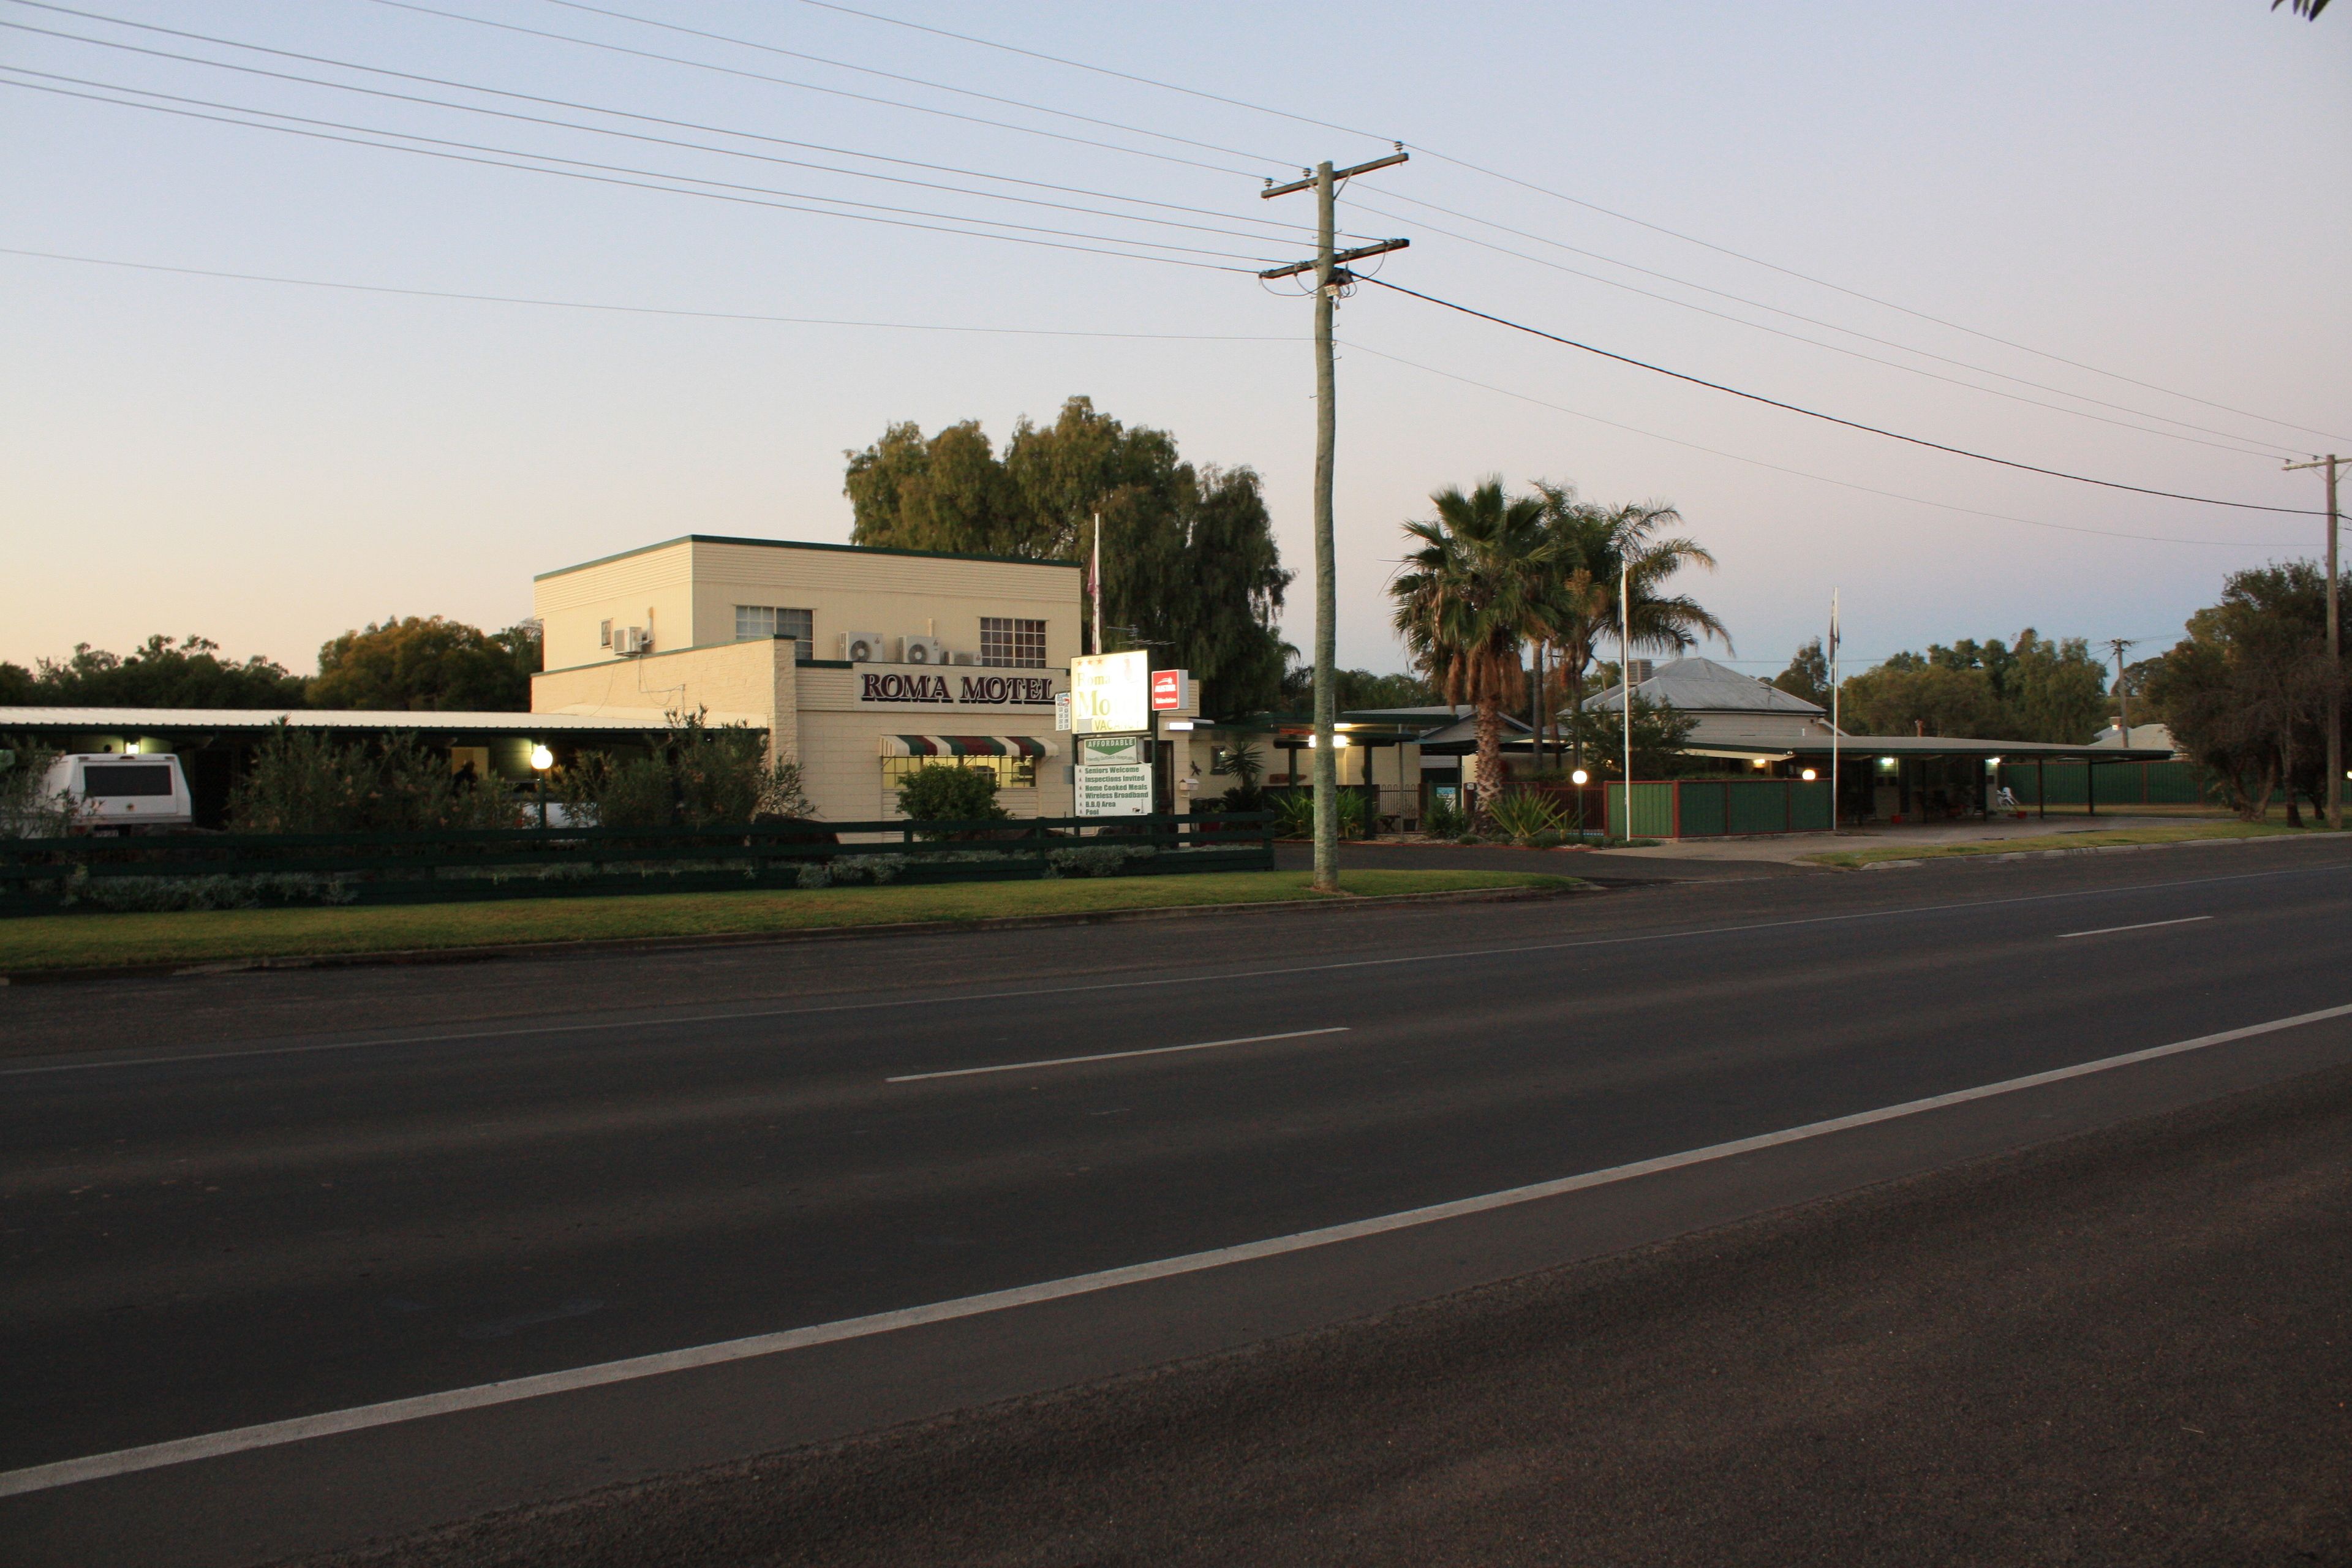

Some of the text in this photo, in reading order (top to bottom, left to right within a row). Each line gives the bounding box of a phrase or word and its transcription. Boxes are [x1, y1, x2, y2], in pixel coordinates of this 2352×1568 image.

[1077, 673, 1110, 687] Roma
[861, 674, 953, 704] ROMA
[959, 676, 1055, 705] MOTEL
[1095, 719, 1140, 731] VACA
[1088, 739, 1133, 747] AFFORDABLE
